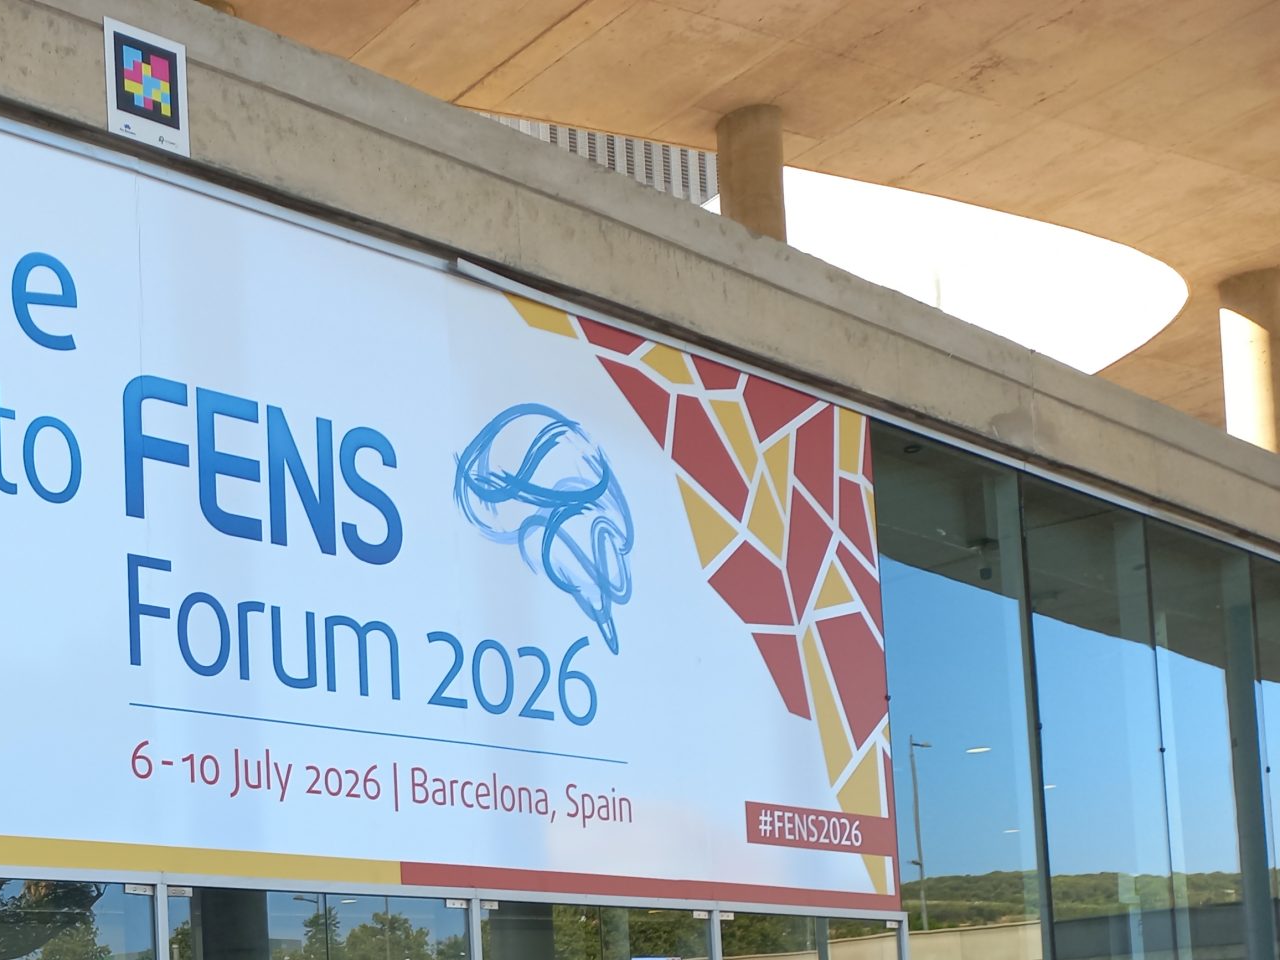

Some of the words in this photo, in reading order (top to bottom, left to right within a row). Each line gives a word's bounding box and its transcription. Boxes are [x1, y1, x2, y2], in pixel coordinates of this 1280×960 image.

[122, 374, 405, 568] FENS
[126, 552, 402, 701] Forum
[426, 630, 599, 727] 2026
[230, 748, 293, 802] July
[305, 764, 381, 800] 2026
[411, 767, 556, 823] Barcelona,
[565, 784, 633, 828] Spain
[758, 809, 862, 846] #FENS2026
